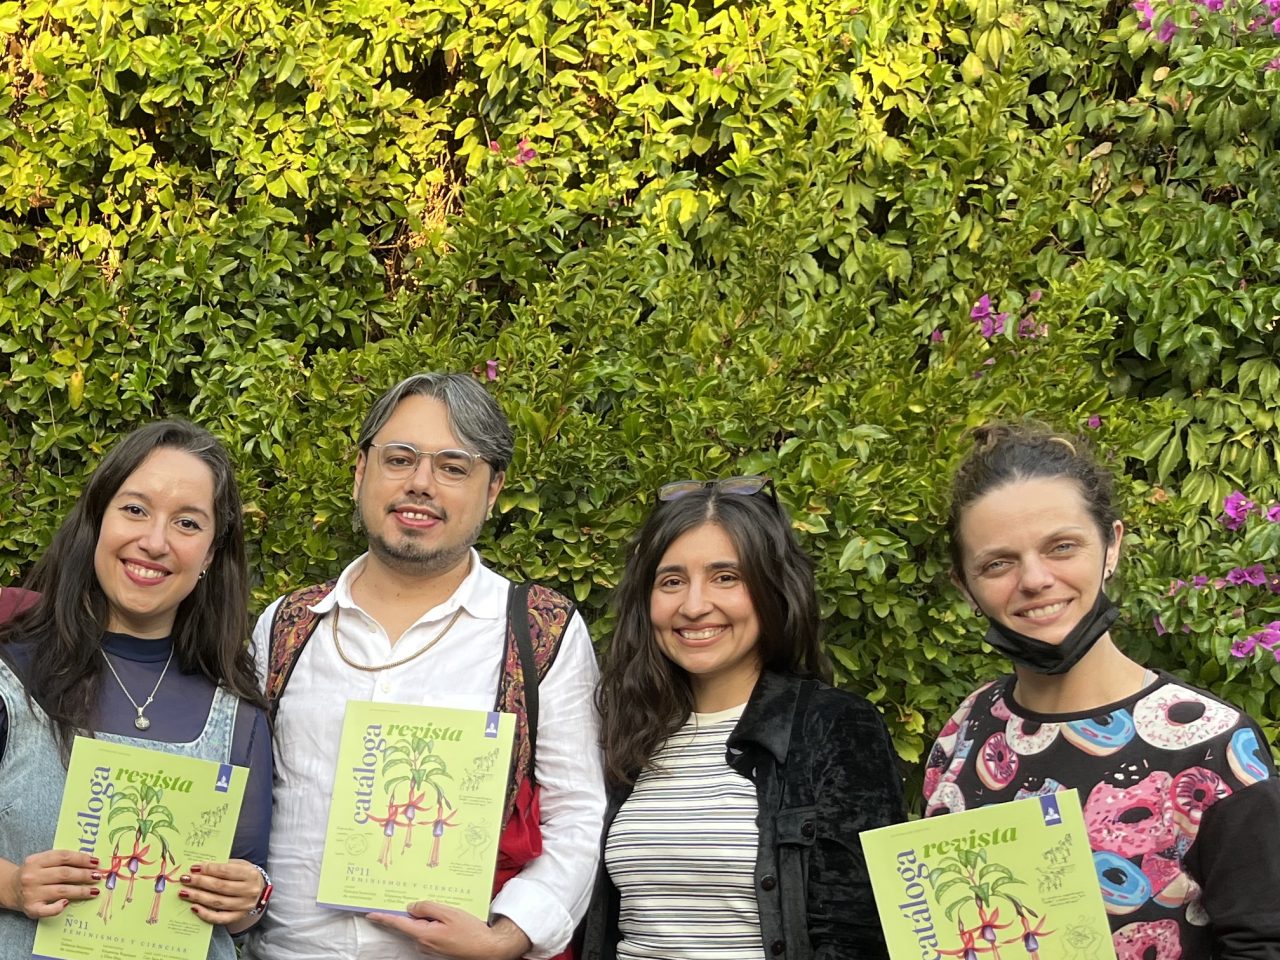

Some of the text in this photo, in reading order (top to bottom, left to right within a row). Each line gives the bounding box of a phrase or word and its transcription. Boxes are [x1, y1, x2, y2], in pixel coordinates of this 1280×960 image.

[386, 722, 464, 742] revista
[115, 767, 193, 794] revista
[352, 724, 389, 825] catáloga
[77, 766, 115, 853] táloga
[922, 826, 1017, 859] revista
